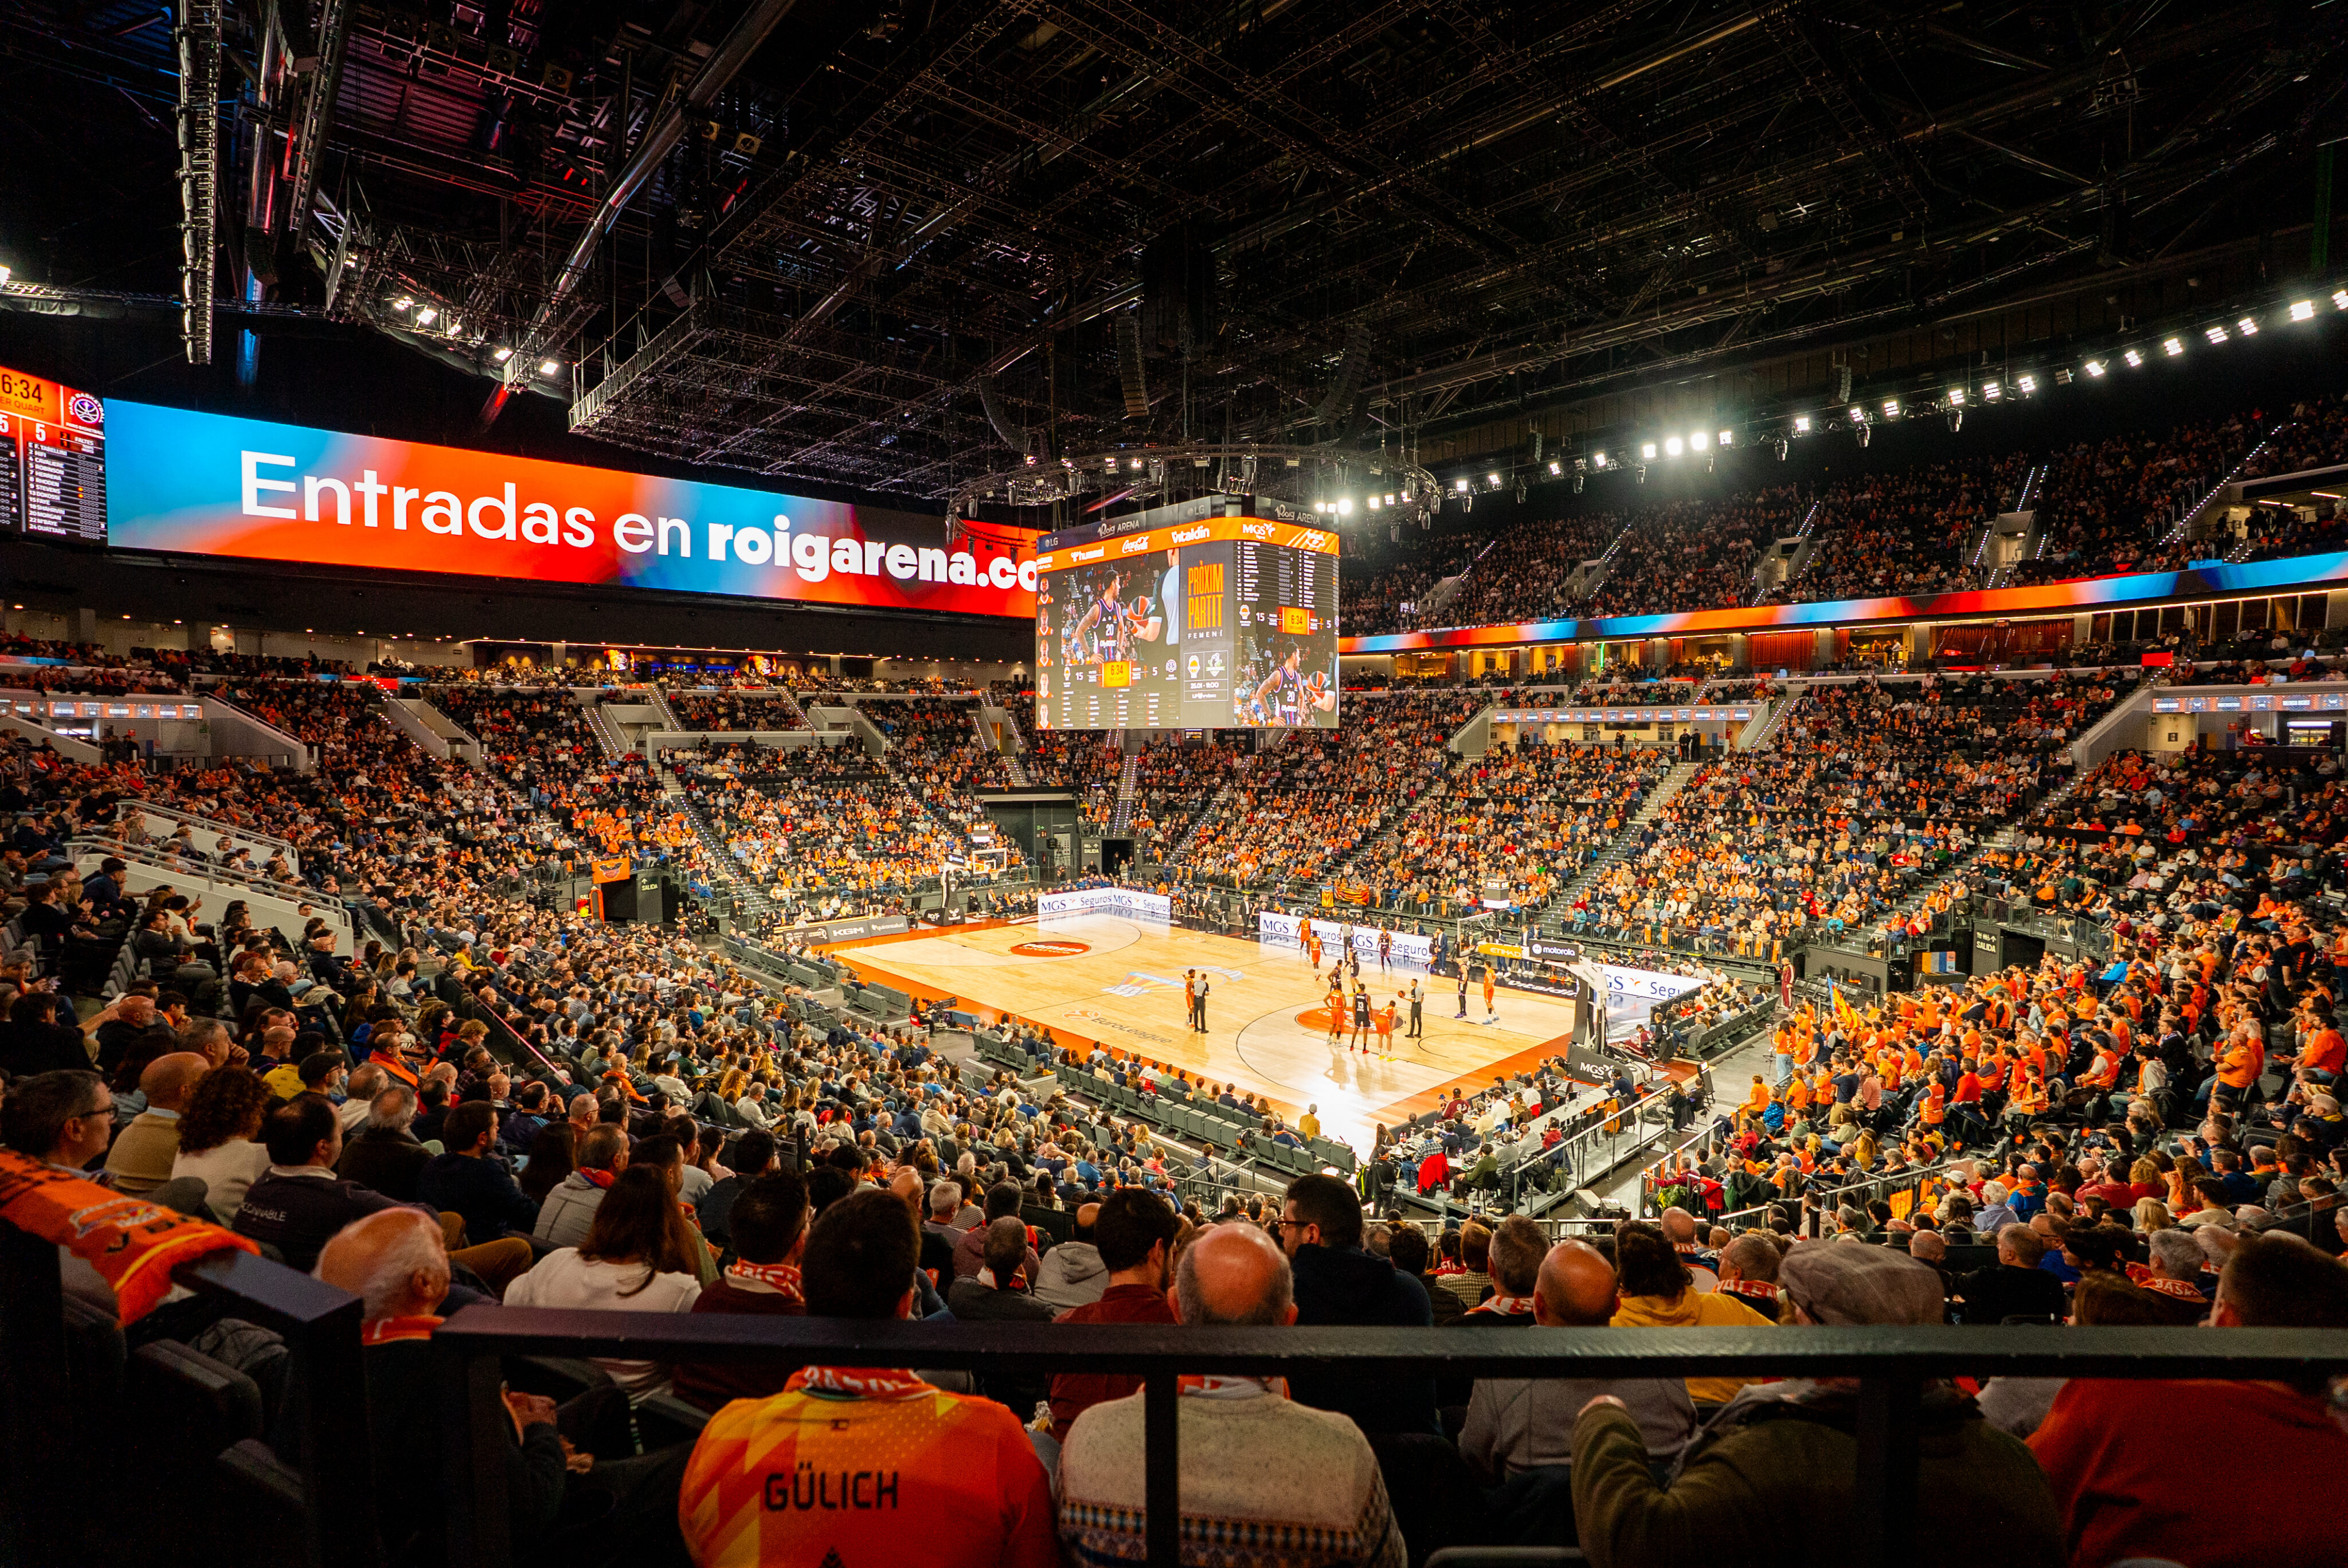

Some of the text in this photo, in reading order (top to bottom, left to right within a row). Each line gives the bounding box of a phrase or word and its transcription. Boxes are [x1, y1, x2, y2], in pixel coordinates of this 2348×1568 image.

[2, 374, 42, 403] 6:34
[0, 395, 45, 414] ER QUART
[36, 423, 46, 441] 5
[1193, 505, 1204, 515] LG
[241, 450, 1036, 593] Entradas en roigarena.co
[1297, 512, 1320, 525] ARENA
[1117, 520, 1140, 533] ARENA
[1242, 524, 1266, 535] MGS
[1171, 526, 1210, 543] Vitaldin
[1050, 537, 1058, 546] LG
[1188, 560, 1224, 595] PRÒXIM
[1188, 594, 1224, 629] PARTIT
[1256, 612, 1265, 622] 15
[1291, 615, 1302, 625] 6:34
[1326, 620, 1331, 629] 5
[1105, 624, 1114, 636] 20
[1188, 630, 1223, 639] FEMENÍ
[1075, 672, 1083, 681] 15
[1111, 665, 1123, 675] 6:34
[1152, 667, 1158, 676] 5
[1287, 691, 1295, 703] 20
[1042, 895, 1112, 912] MGS Seguros
[1113, 894, 1171, 913] MGS Seguros
[832, 927, 864, 937] KGM
[1263, 919, 1289, 934] MGS
[1352, 932, 1373, 948] GS
[1490, 947, 1521, 958] ETIHAD
[1543, 947, 1575, 957] motorola
[1976, 941, 1997, 953] SALIDA
[1606, 974, 1623, 990] GS
[1650, 982, 1683, 999] Segu
[1091, 1017, 1172, 1044] EuroLeague
[1580, 1061, 1605, 1076] MGS
[2155, 1279, 2194, 1296] BASK
[765, 1461, 898, 1511] GÜLICH
